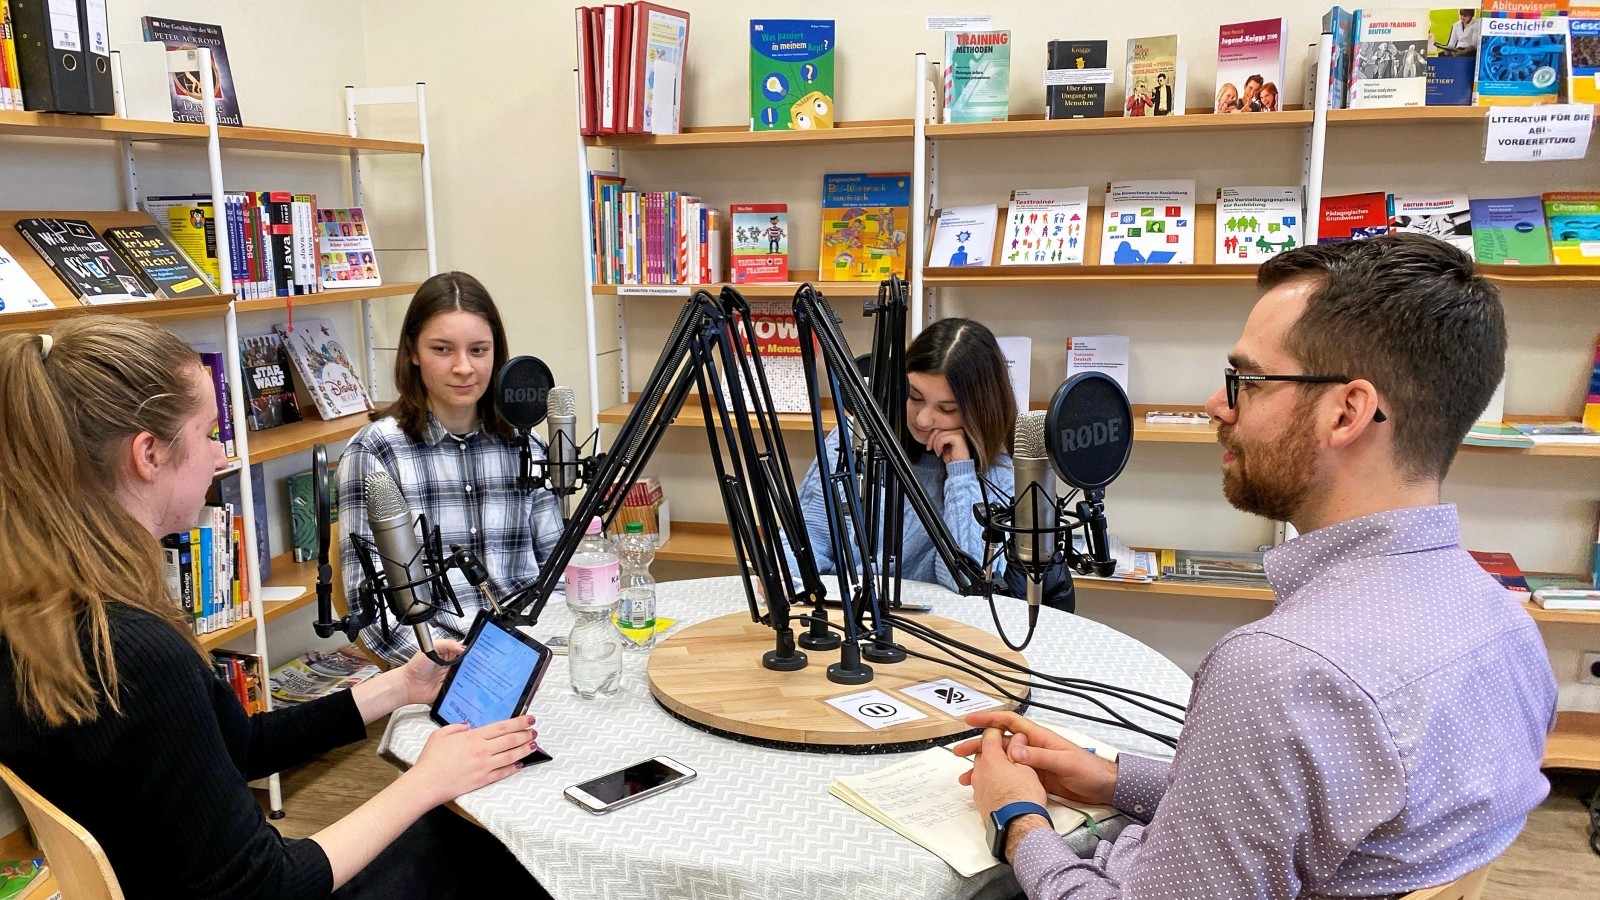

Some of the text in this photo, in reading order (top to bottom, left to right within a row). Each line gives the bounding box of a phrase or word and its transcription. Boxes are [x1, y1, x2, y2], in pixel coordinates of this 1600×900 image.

[1492, 1, 1556, 11] Abiturwissen
[171, 24, 197, 32] Geschichte
[1489, 20, 1554, 31] Geschichte
[154, 32, 220, 46] PETER ACKROYD
[762, 32, 803, 41] Was passiert
[957, 33, 1008, 45] TRAINING
[1221, 34, 1266, 45] Jugend-Knigge
[772, 42, 778, 50] in
[780, 41, 806, 50] meinem
[183, 100, 202, 111] Das
[1492, 115, 1547, 123] LITERATUR
[1498, 137, 1575, 146] VORBEREITUNG
[113, 230, 144, 239] Mich
[122, 238, 164, 248] kriegt
[229, 222, 238, 271] Entwurfsmuster
[238, 223, 247, 270] Entwurfsmuster
[131, 249, 151, 257] ihr
[283, 236, 293, 271] Java
[140, 256, 178, 267] nicht!
[252, 365, 284, 378] STAR
[253, 374, 285, 390] WARS
[504, 388, 547, 403] RØDE
[221, 392, 229, 423] PowerPoint
[1061, 417, 1122, 453] RØDE
